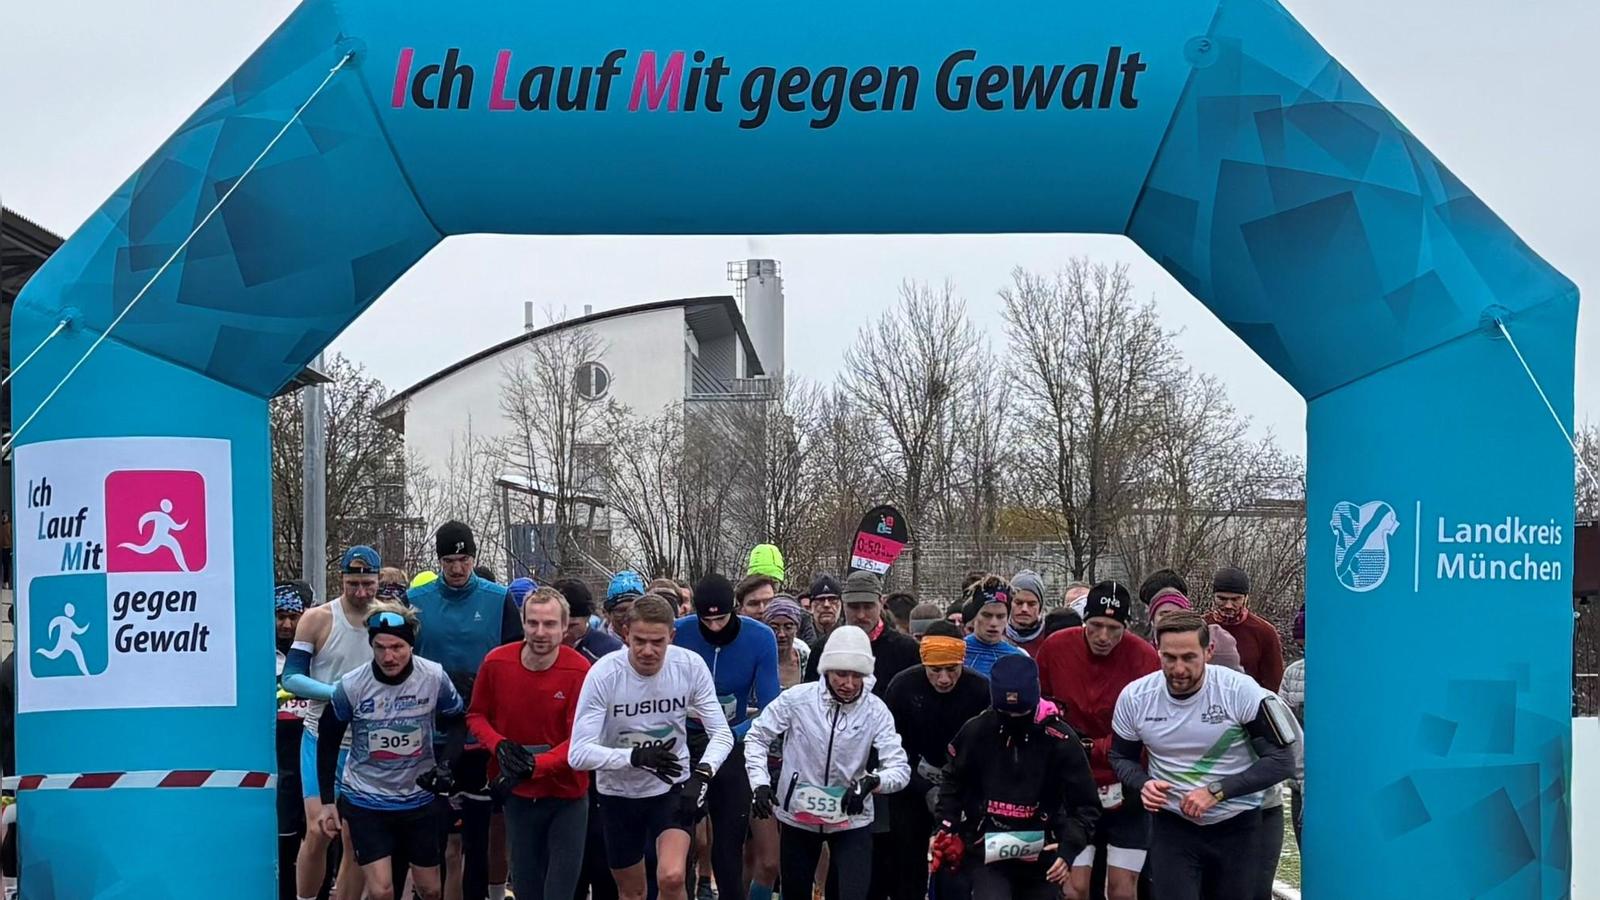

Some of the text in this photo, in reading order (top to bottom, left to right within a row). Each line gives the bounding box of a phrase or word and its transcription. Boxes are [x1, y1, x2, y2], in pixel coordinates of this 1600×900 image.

[391, 46, 1147, 129] Ich Lauf Mit gegen Gewalt
[28, 477, 52, 508] Ich
[38, 507, 88, 540] Lauf
[1437, 516, 1562, 545] Landkreis
[61, 540, 103, 571] Mit
[1436, 553, 1561, 580] München
[113, 589, 196, 620] gegen
[115, 622, 209, 653] Gewalt
[613, 696, 686, 717] FUSION
[380, 734, 410, 748] 305
[806, 797, 837, 812] 553
[999, 844, 1031, 858] 606
